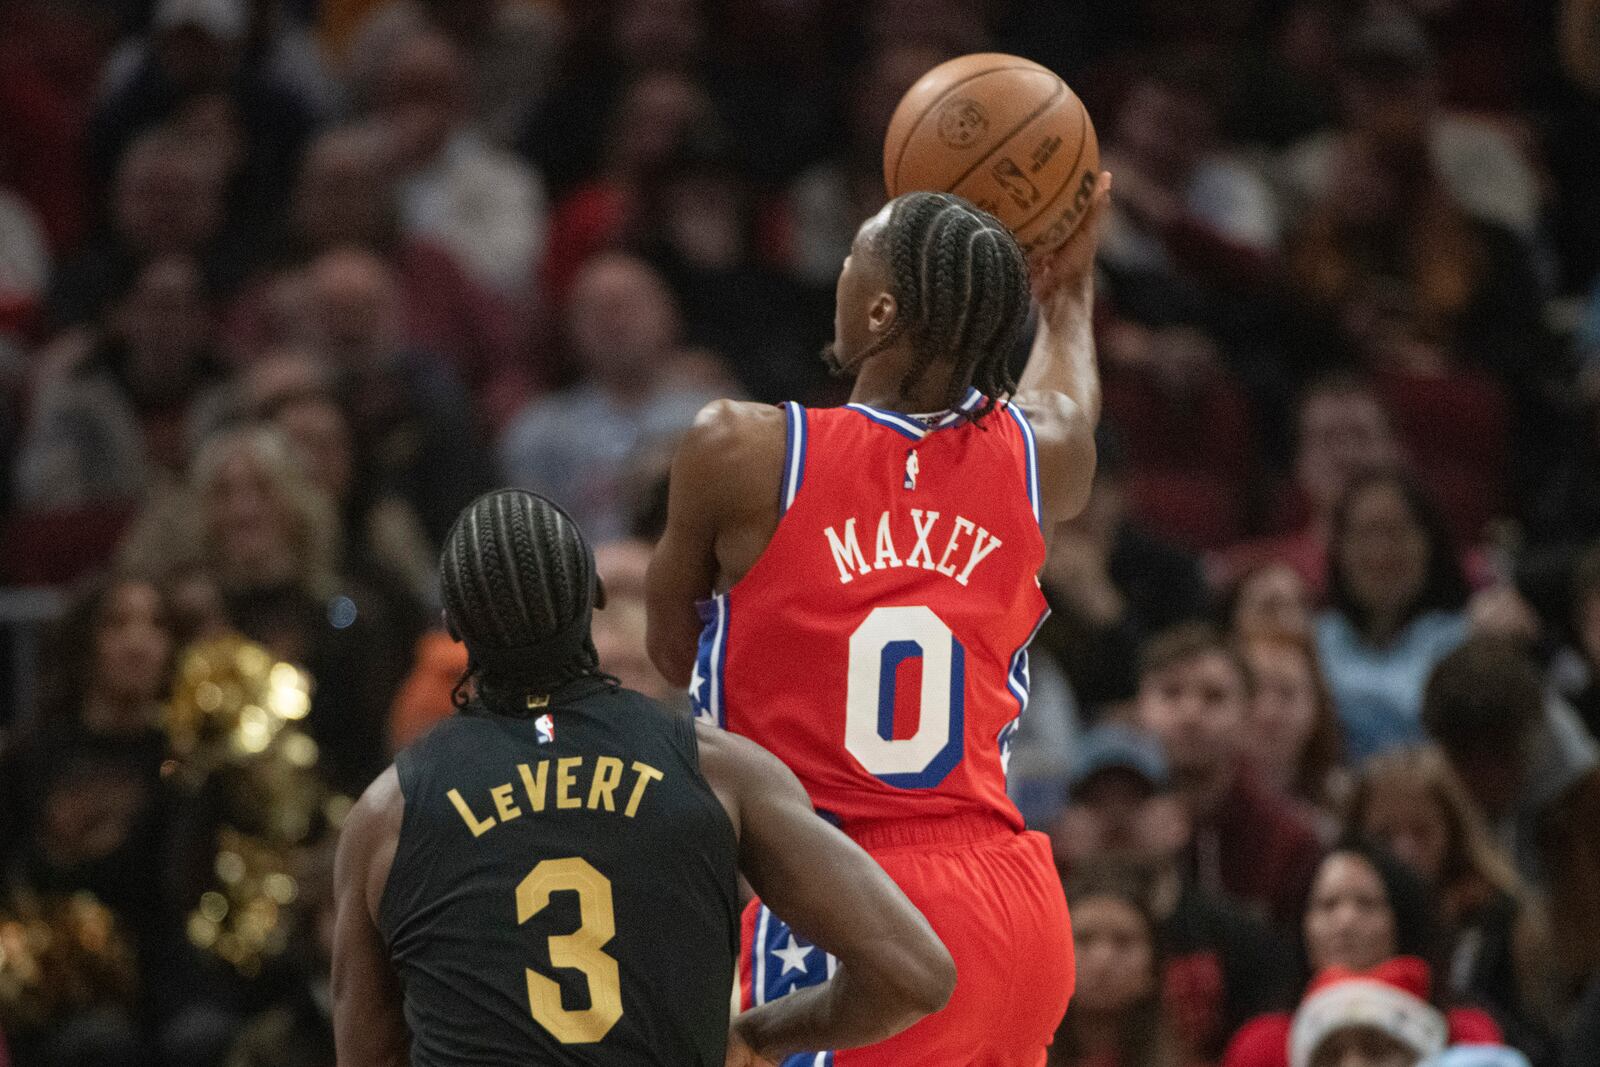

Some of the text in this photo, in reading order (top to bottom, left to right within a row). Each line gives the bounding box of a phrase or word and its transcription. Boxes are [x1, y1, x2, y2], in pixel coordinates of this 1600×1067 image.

[824, 510, 1003, 586] MAXEY
[845, 606, 965, 789] 0
[515, 857, 624, 1044] 3
